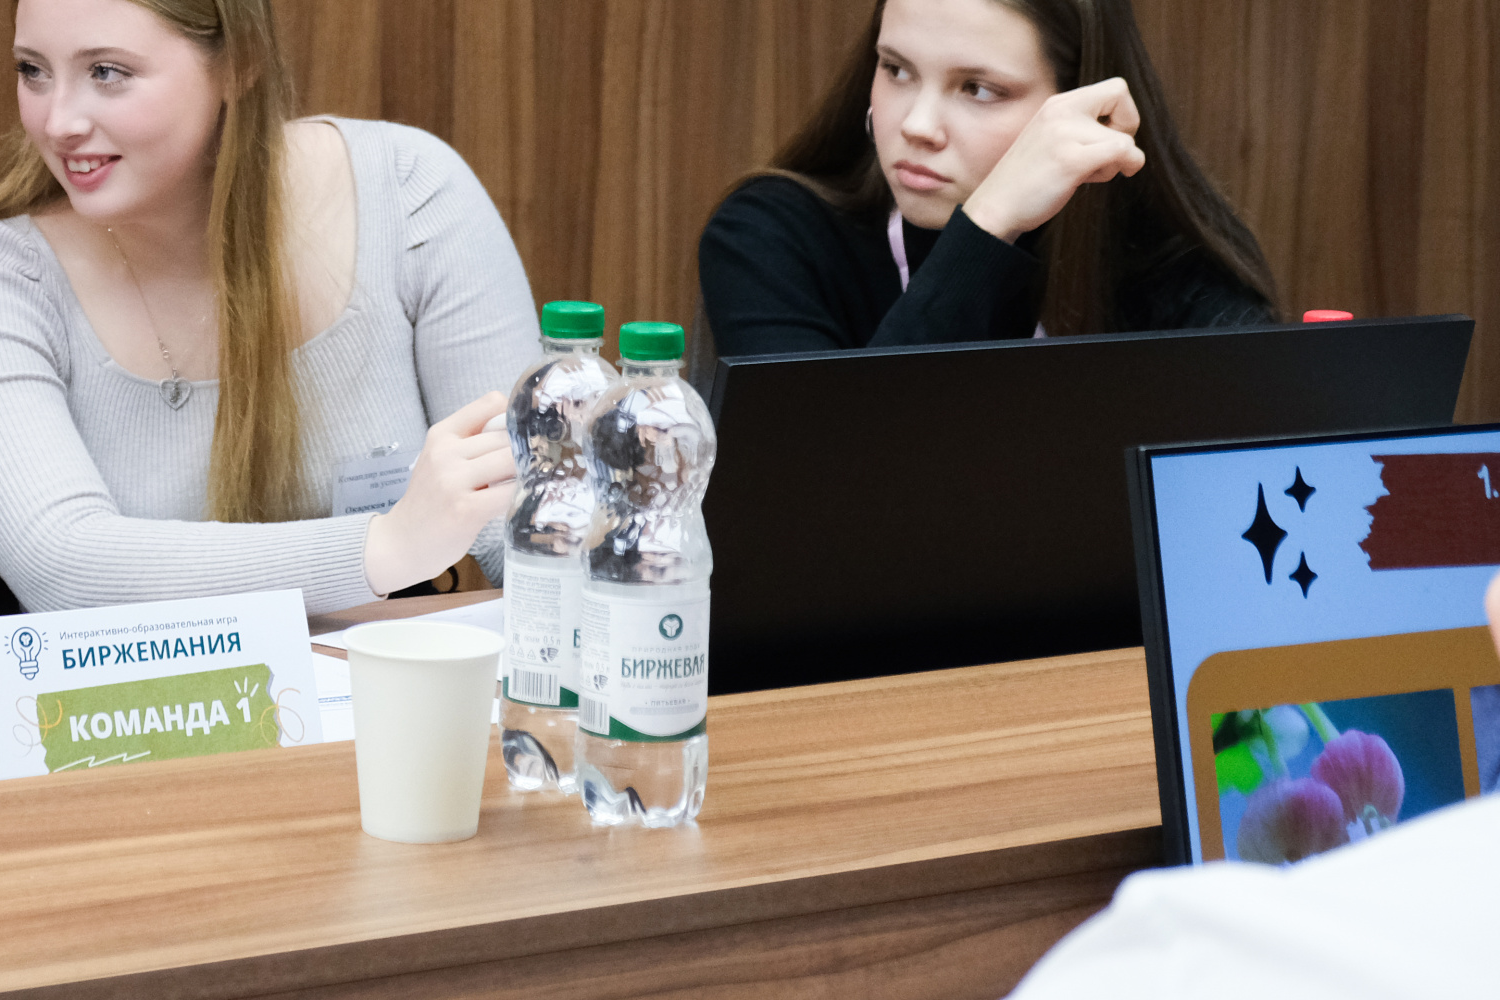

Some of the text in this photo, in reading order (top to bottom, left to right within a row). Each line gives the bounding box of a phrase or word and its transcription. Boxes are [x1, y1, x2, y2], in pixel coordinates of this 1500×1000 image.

[1477, 463, 1499, 500] 1.
[59, 615, 238, 640] Интерактивно-образовательная игра
[61, 631, 242, 670] БИРЖЕМАНИЯ
[621, 653, 705, 680] БИРЖЕВАЯ
[69, 696, 251, 742] КОМАНДА 1
